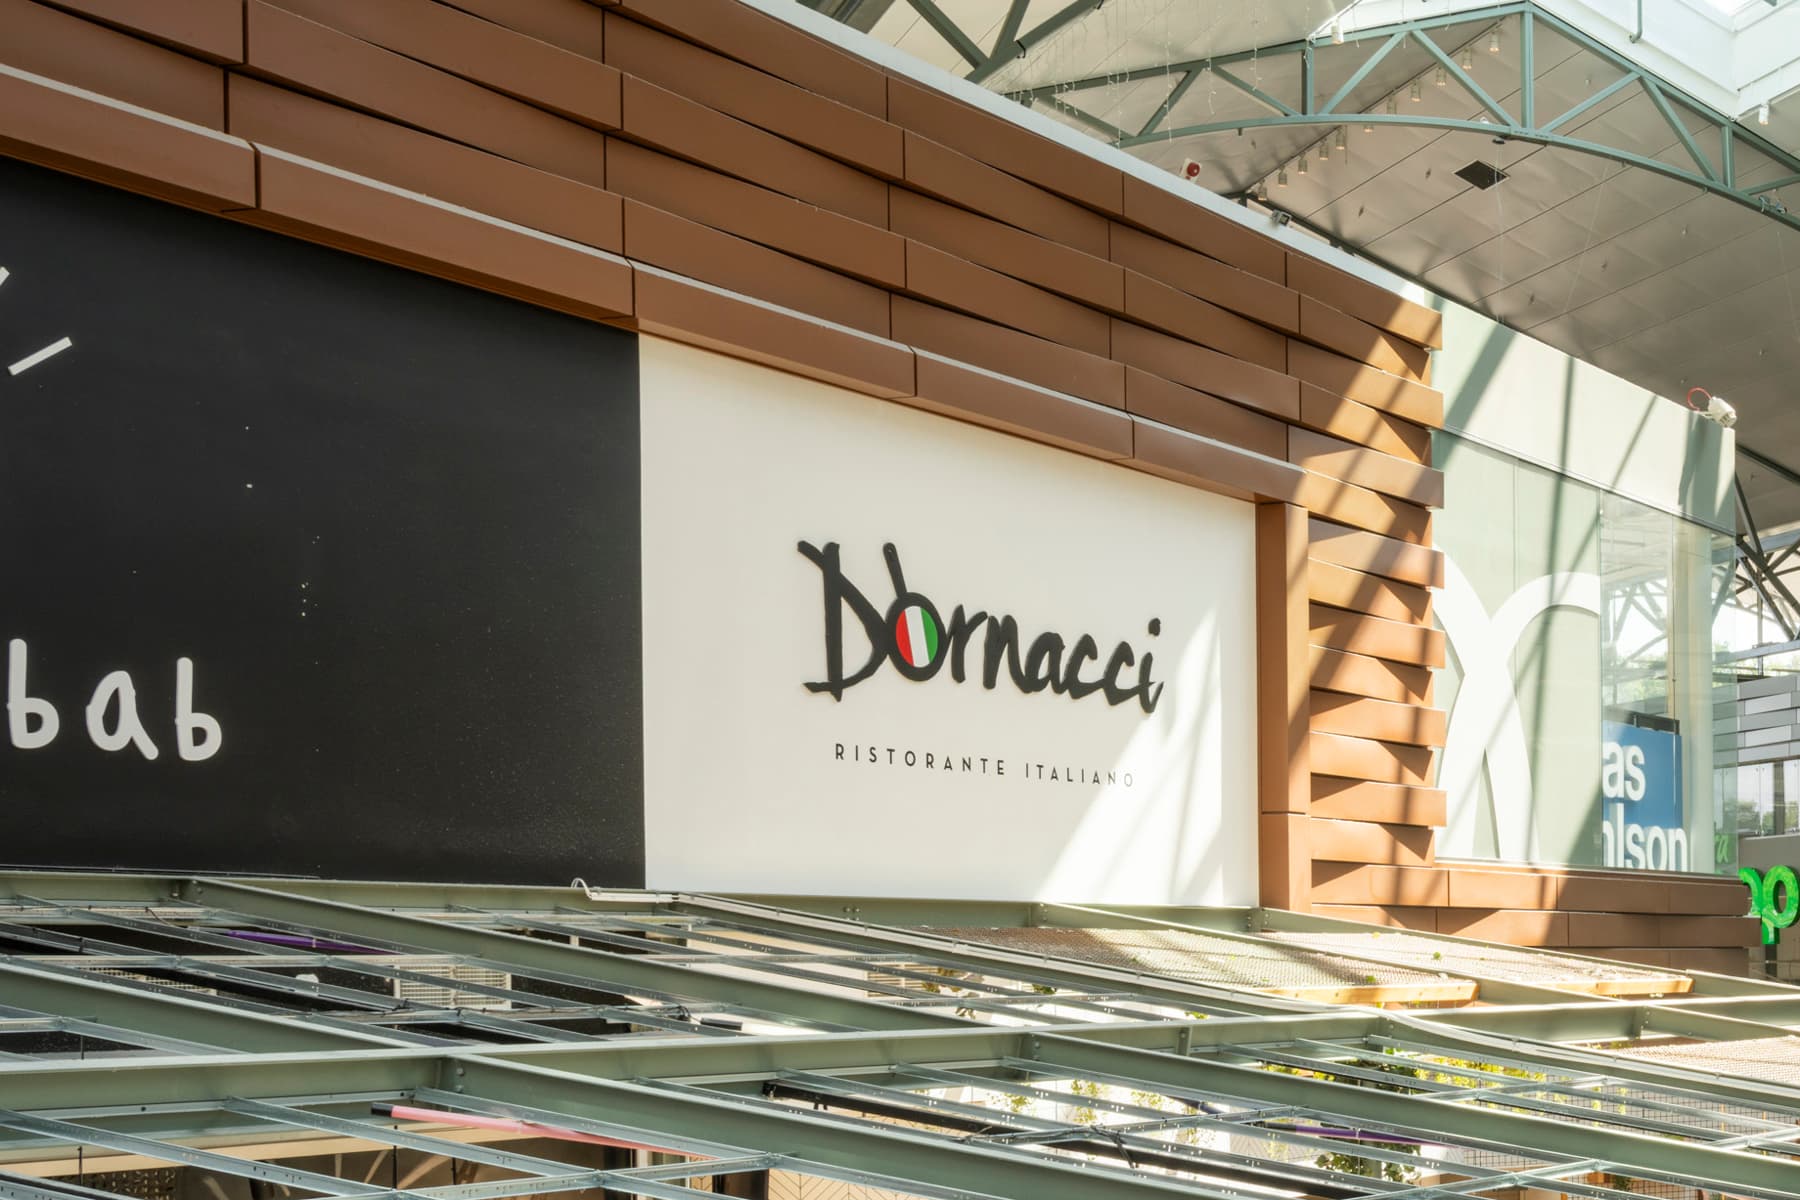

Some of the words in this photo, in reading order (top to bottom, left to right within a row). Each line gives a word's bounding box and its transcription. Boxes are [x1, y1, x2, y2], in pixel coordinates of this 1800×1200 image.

[797, 540, 1164, 713] Dornacci
[835, 743, 1005, 776] RISTORANTE
[1025, 763, 1134, 787] ITALIANO
